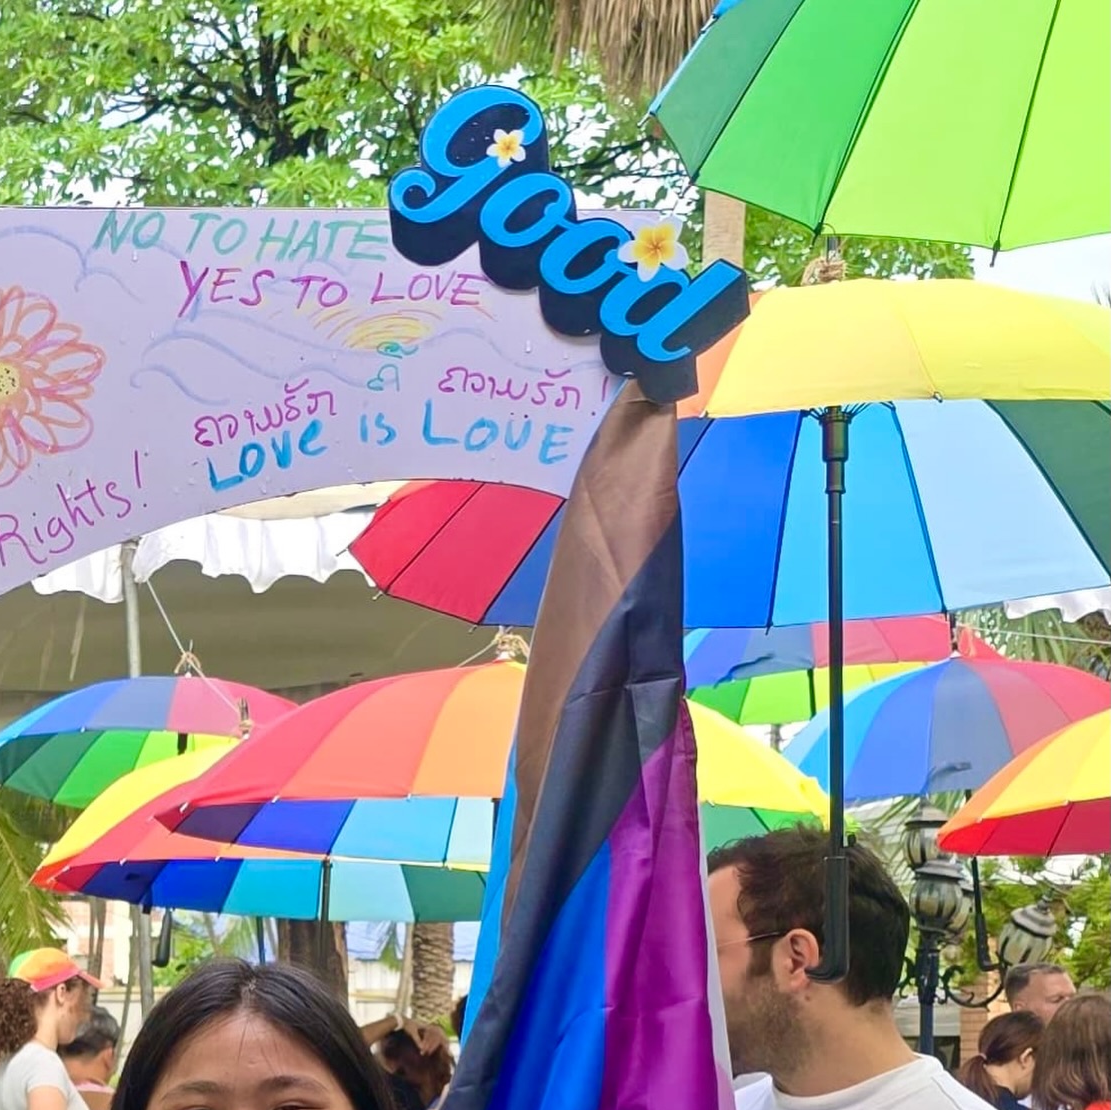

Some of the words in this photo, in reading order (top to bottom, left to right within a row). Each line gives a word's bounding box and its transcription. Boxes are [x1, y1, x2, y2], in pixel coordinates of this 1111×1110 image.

[92, 210, 166, 254] NO
[185, 213, 248, 255] TO
[255, 217, 389, 261] HATE
[390, 85, 743, 362] good
[178, 261, 275, 318] YES
[290, 275, 348, 309] TO
[370, 272, 488, 306] LOVE
